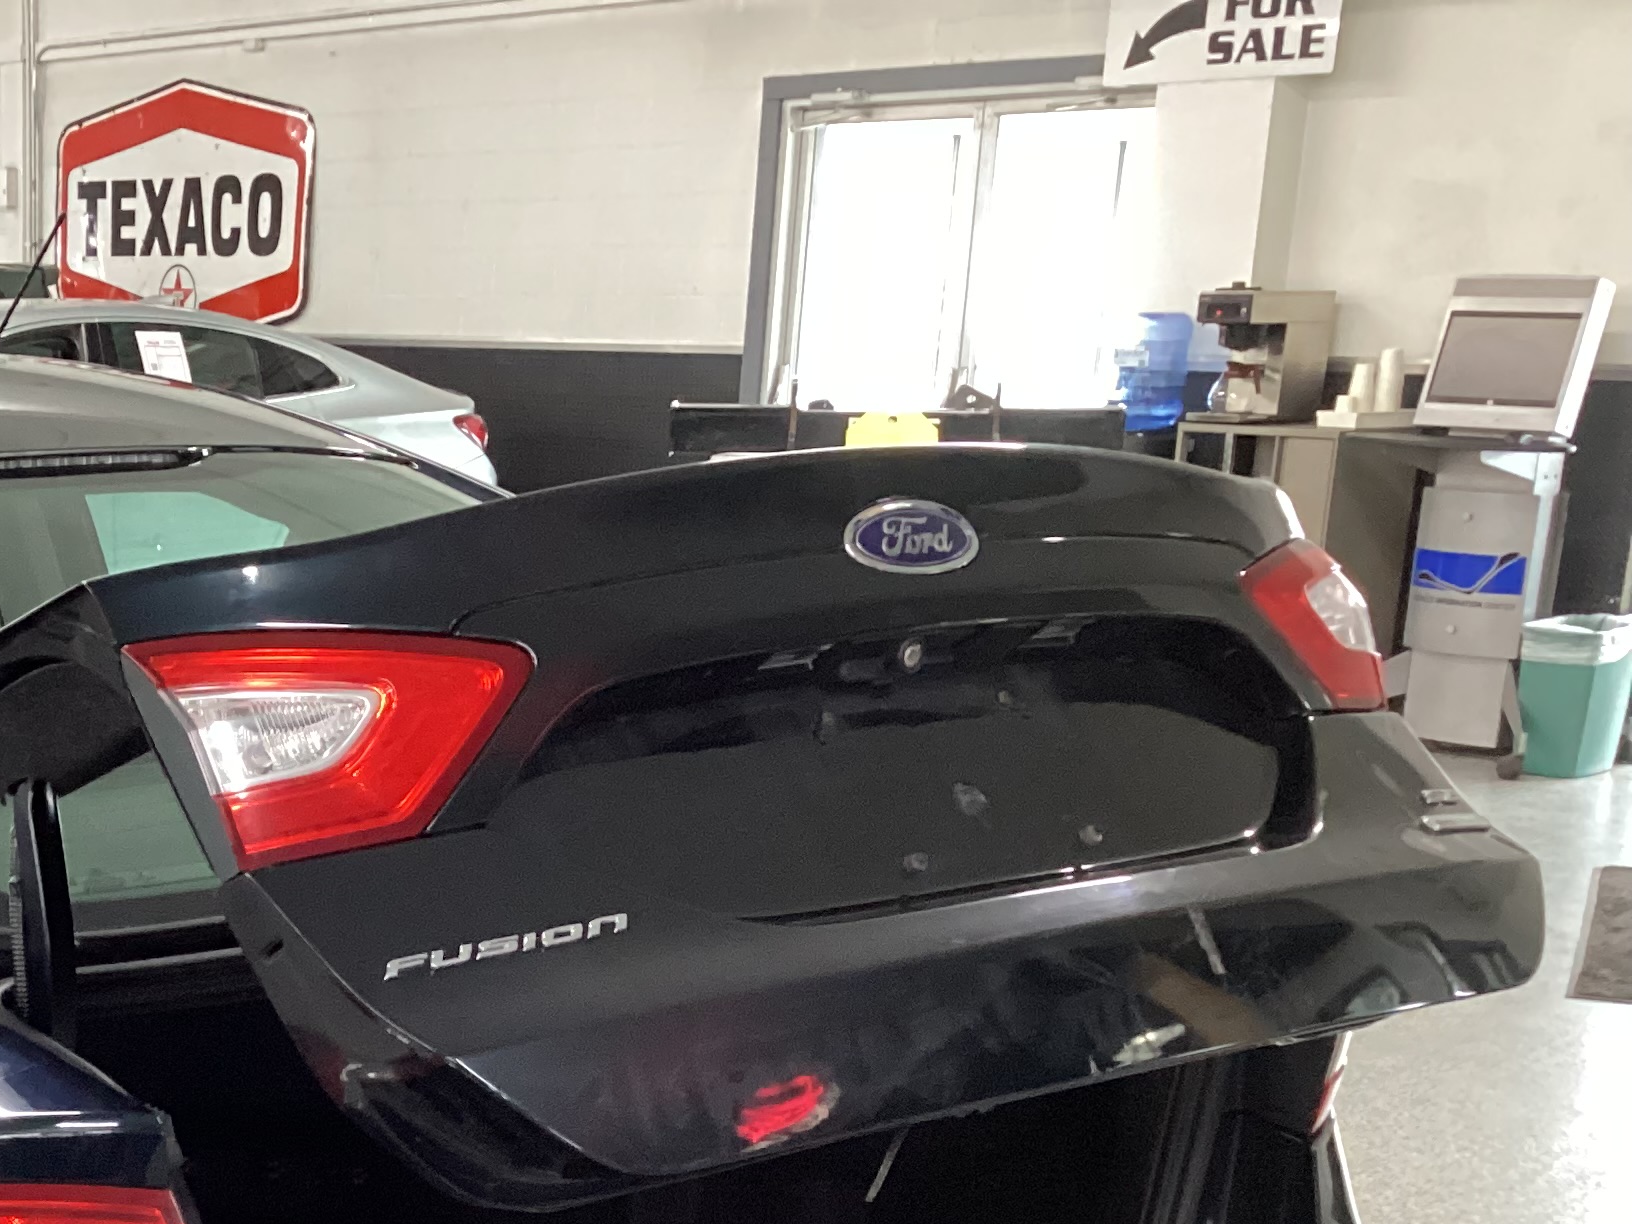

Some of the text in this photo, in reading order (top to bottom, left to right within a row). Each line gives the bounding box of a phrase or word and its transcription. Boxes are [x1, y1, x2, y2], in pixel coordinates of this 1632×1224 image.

[1224, 0, 1316, 22] FOR
[1206, 23, 1327, 66] SALE
[77, 172, 283, 258] TEXACO
[881, 516, 953, 557] Ford
[383, 912, 628, 981] FUSION
